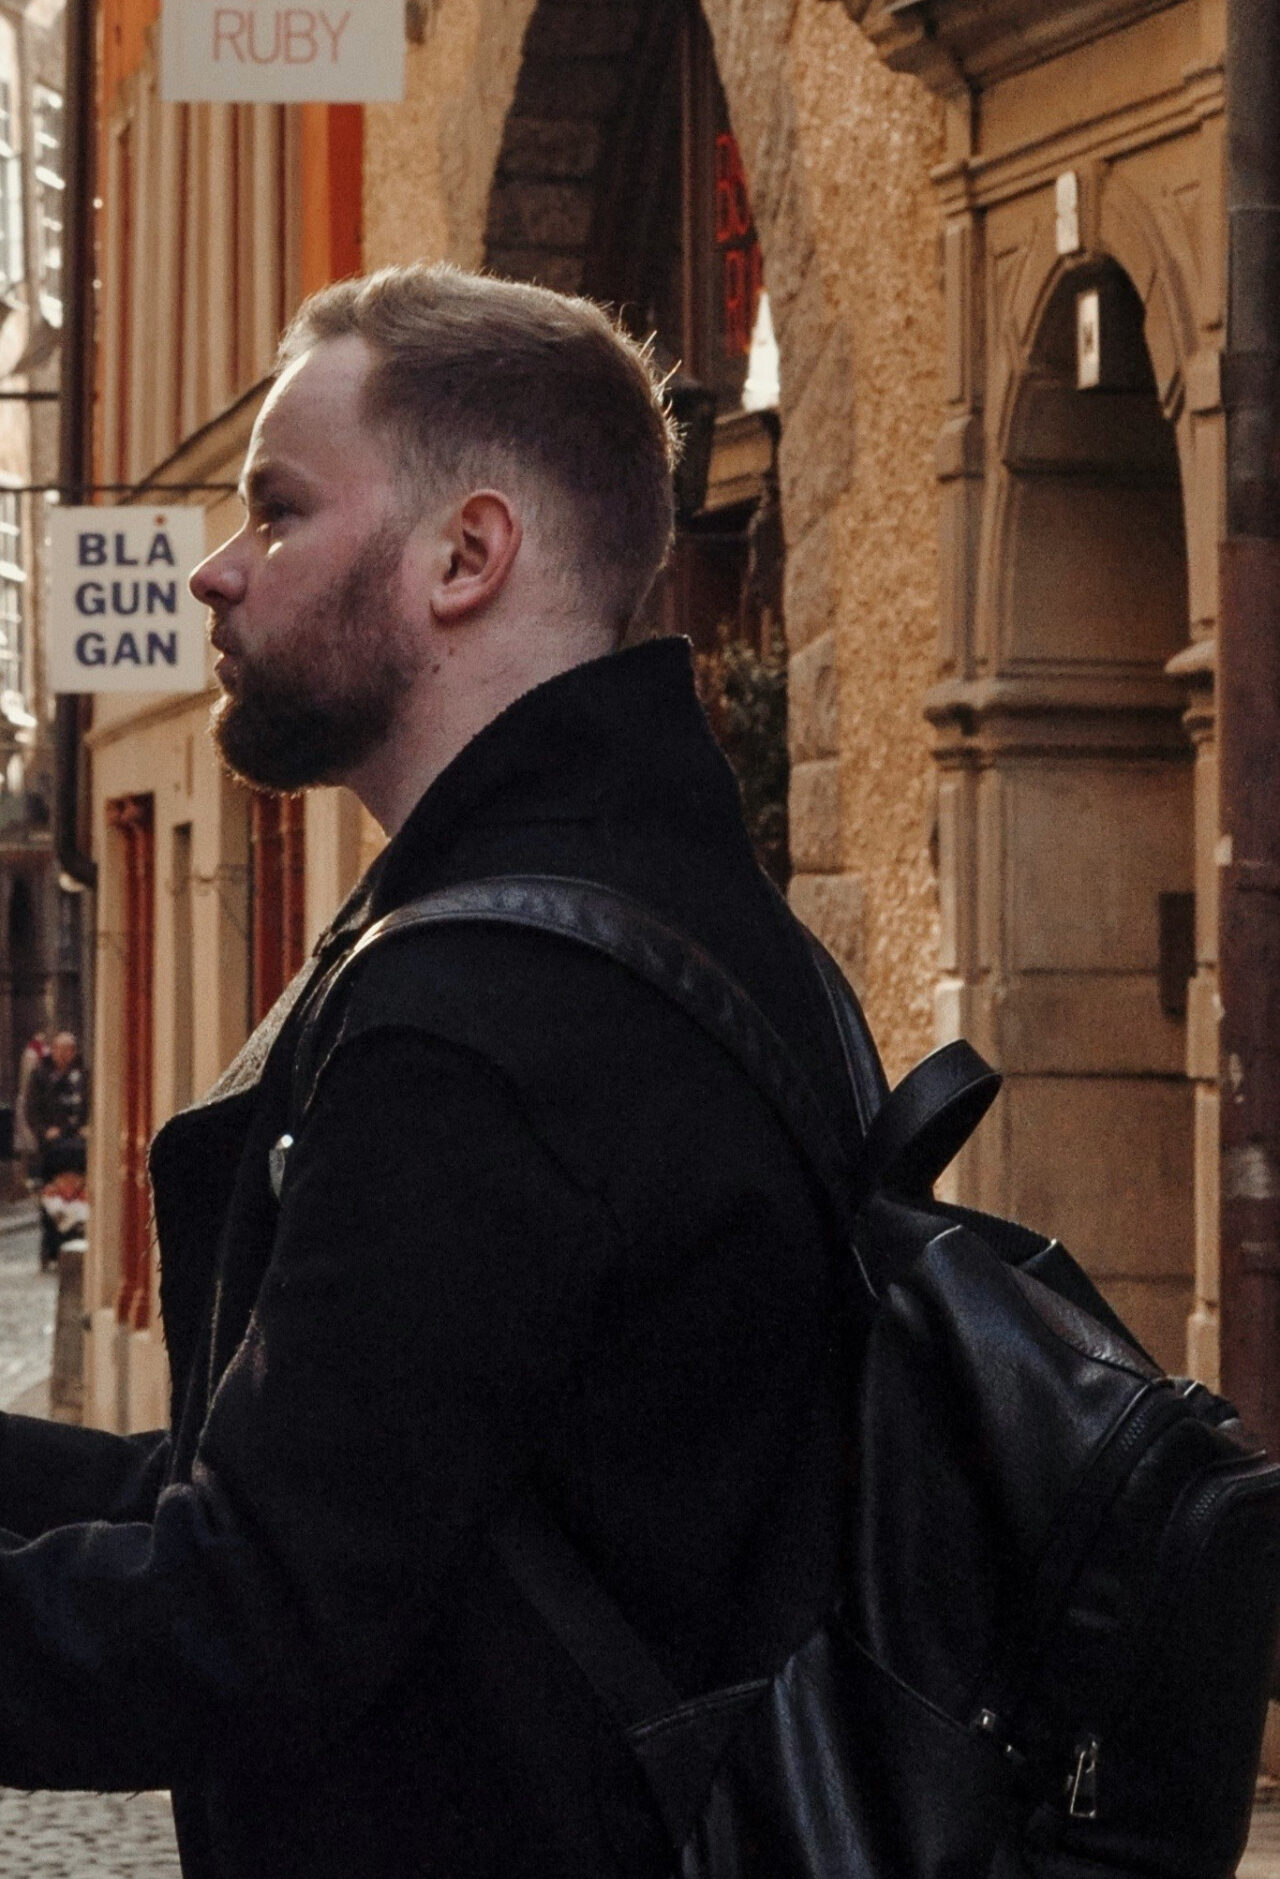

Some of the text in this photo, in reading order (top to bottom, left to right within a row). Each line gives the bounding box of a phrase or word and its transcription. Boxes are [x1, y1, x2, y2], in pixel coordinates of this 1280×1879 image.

[213, 9, 351, 63] RUBY
[78, 515, 174, 566] BLÅ
[75, 581, 177, 615] GUN
[75, 631, 177, 666] GAN
